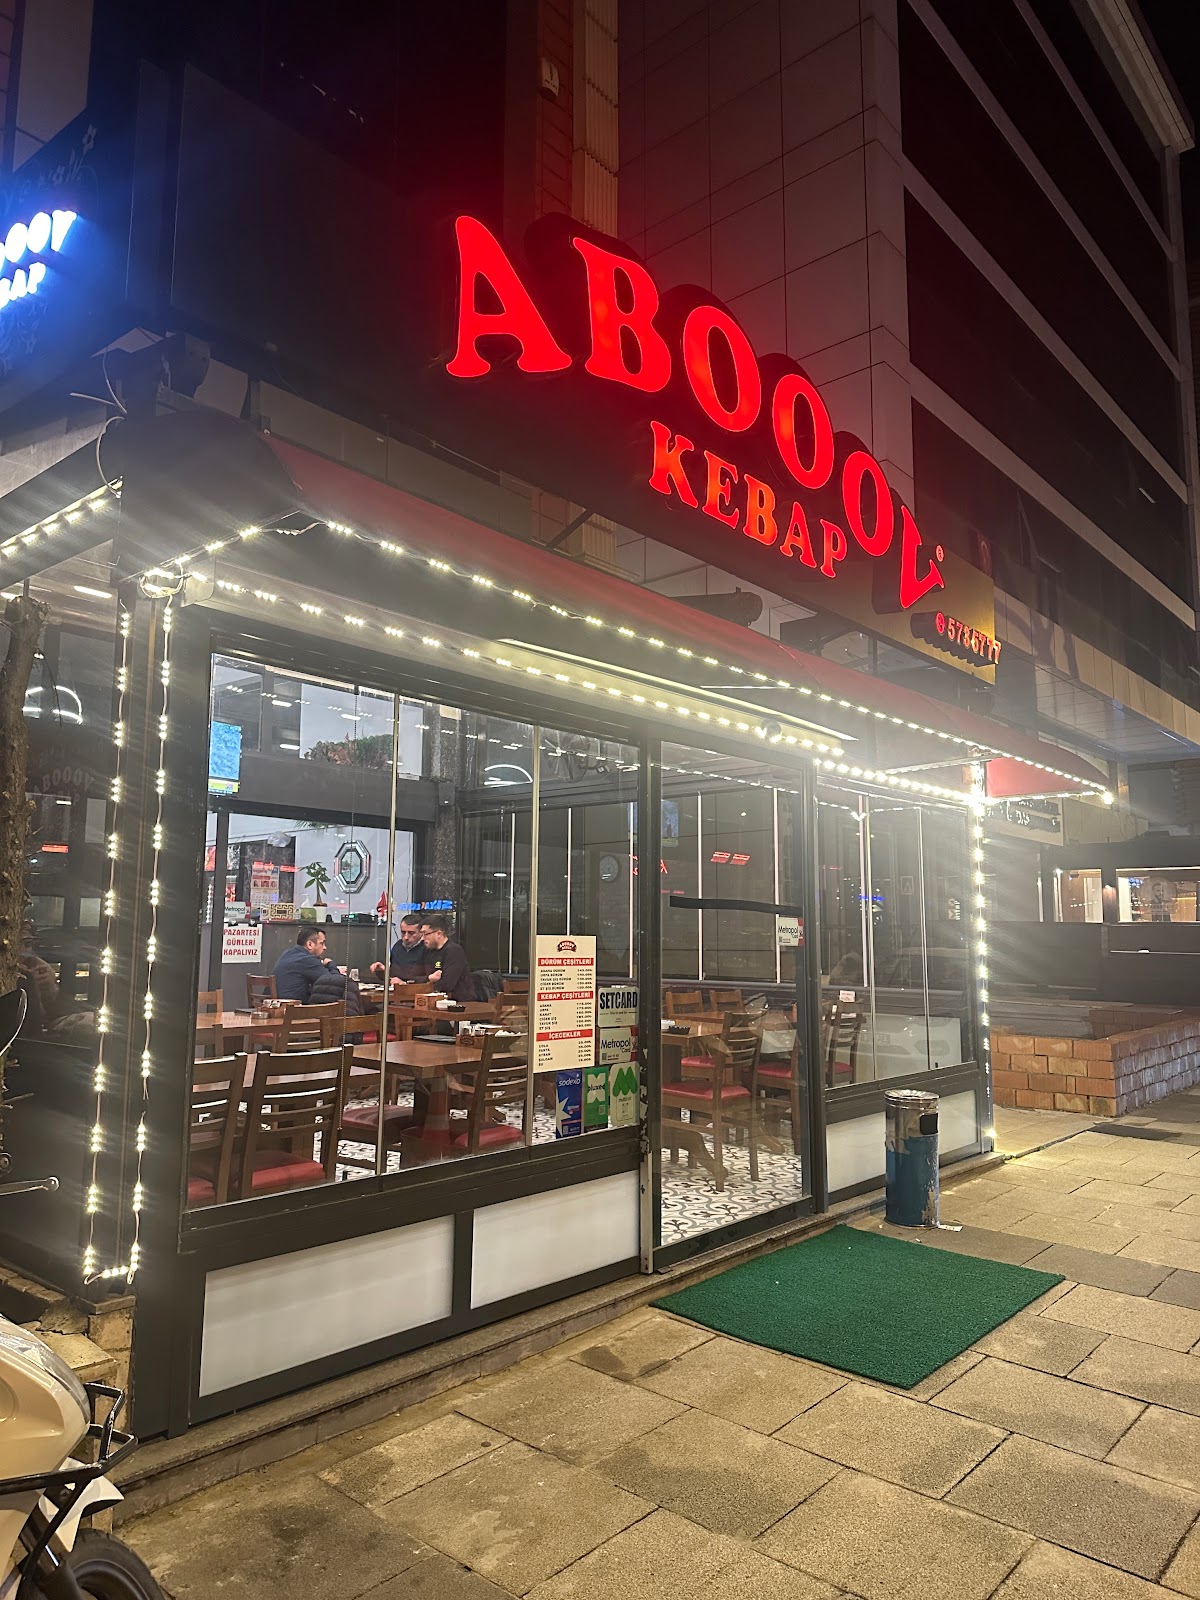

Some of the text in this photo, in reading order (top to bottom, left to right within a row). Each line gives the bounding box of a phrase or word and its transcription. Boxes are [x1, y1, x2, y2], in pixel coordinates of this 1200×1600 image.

[446, 215, 945, 609] ABOOOV
[649, 420, 848, 578] KEBAP
[223, 928, 260, 937] PAZARTESİ
[226, 938, 256, 946] GÜNLERİ
[223, 948, 258, 956] KAPALIYIZ
[563, 958, 592, 966] ÇEŞİTLERİ
[561, 992, 591, 1000] ÇEŞİTLERİ
[599, 991, 638, 1010] SETCARD
[548, 1031, 581, 1040] İÇECEKLER
[601, 1037, 631, 1050] Metropol
[558, 1073, 581, 1087] sodexo
